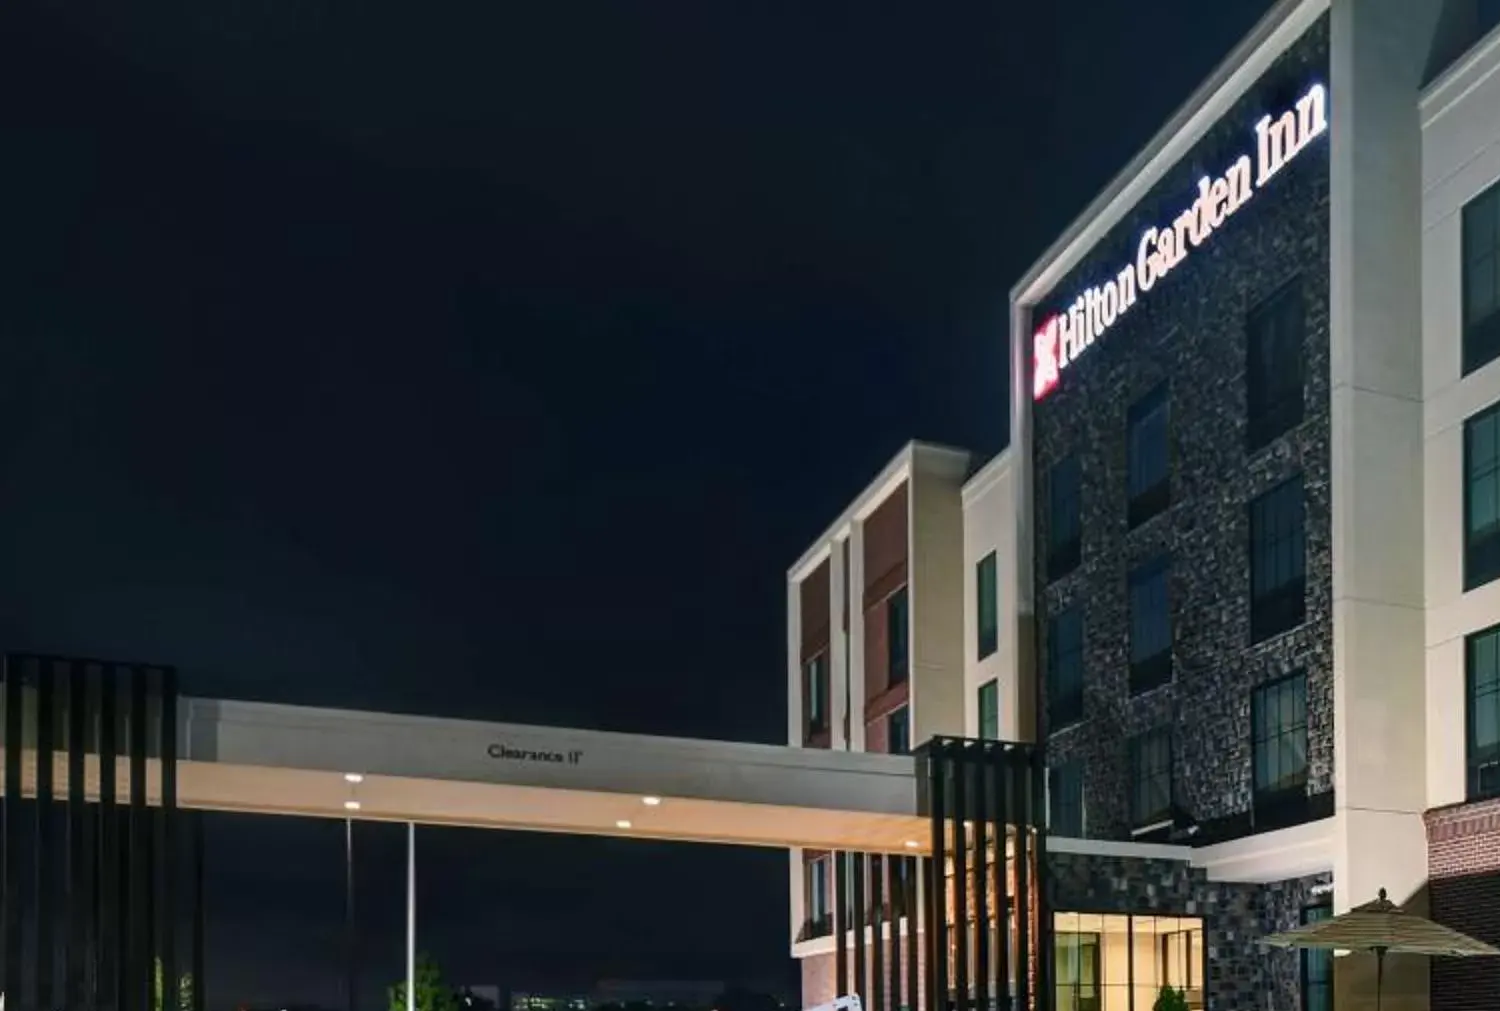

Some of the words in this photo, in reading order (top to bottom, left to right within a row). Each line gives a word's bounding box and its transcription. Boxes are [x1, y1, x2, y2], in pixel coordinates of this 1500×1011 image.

[1058, 262, 1136, 367] Hilton
[1136, 154, 1252, 292] Garden
[1254, 83, 1327, 188] Inn
[487, 744, 563, 763] Clearance
